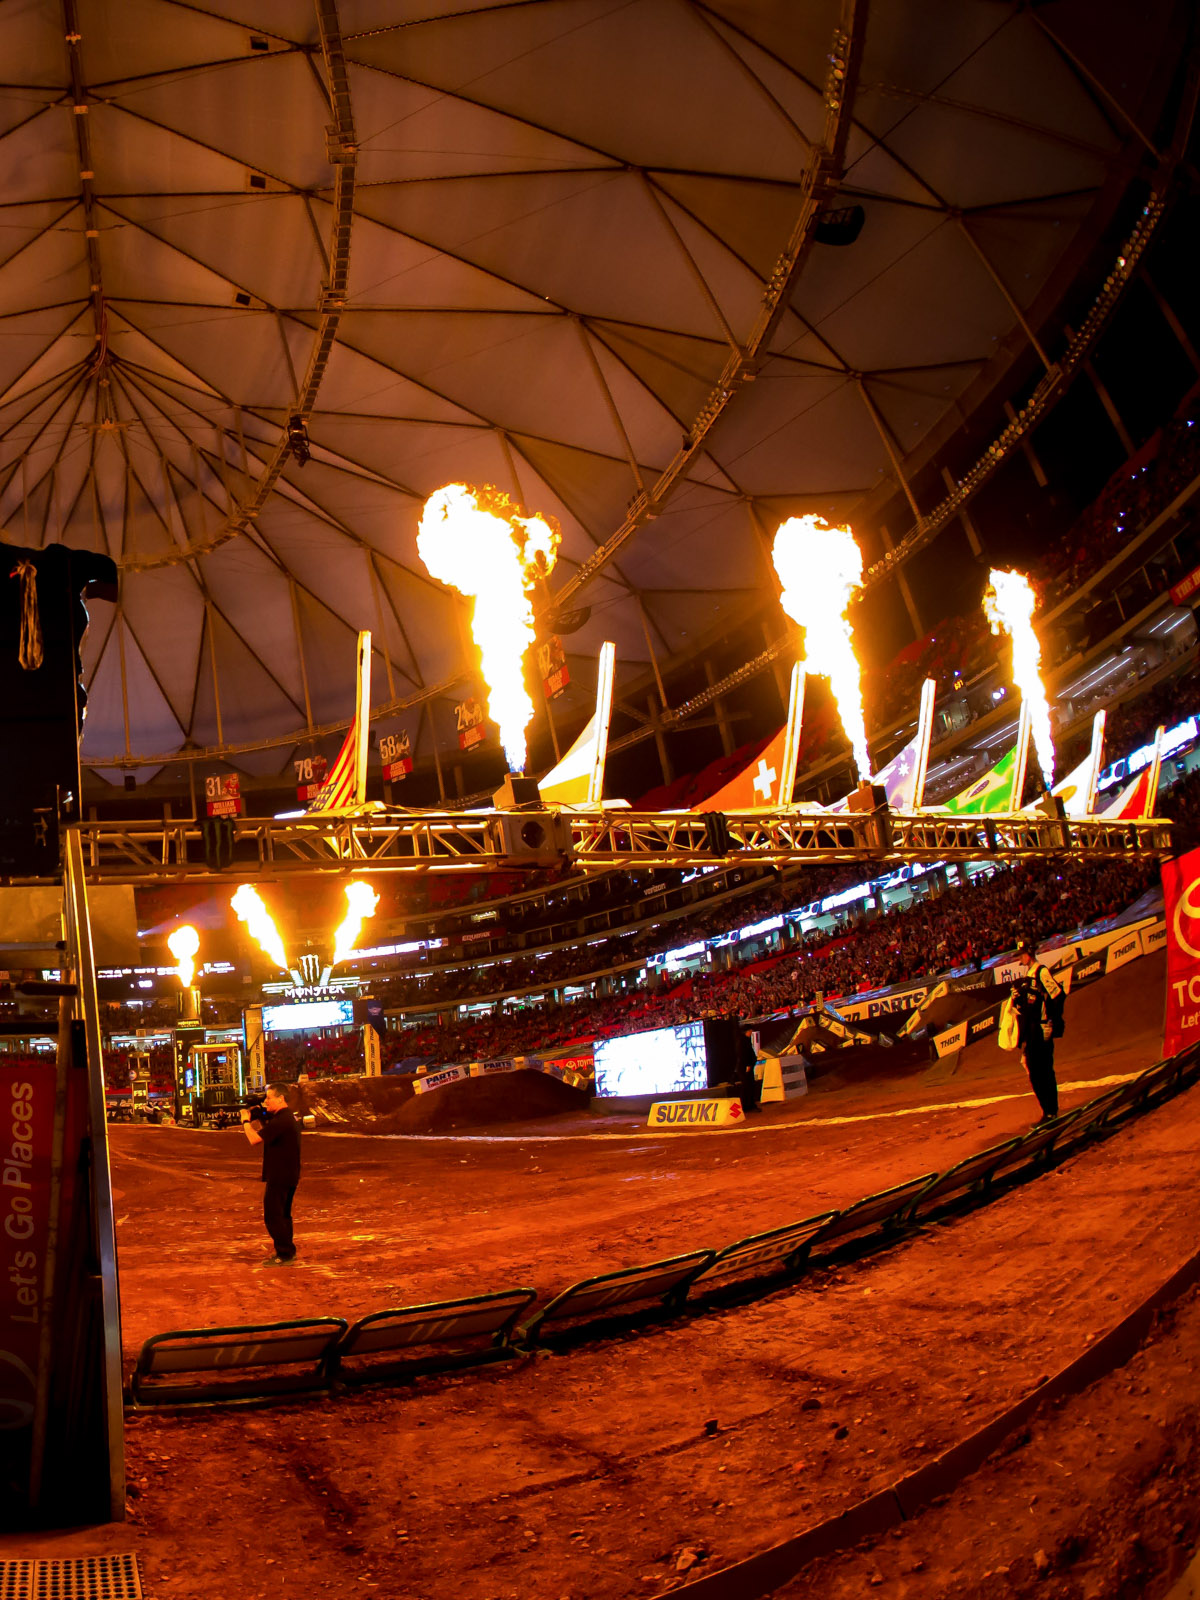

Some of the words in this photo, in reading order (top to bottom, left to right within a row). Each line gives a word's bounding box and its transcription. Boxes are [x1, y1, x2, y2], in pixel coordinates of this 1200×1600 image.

[379, 735, 396, 760] 58
[294, 758, 314, 782] 78
[206, 777, 221, 797] 31
[1113, 941, 1136, 959] THOR
[1077, 961, 1101, 980] THOR
[284, 984, 345, 998] MONSTER
[868, 992, 925, 1017] PARTS
[971, 1016, 994, 1033] THOR
[940, 1034, 961, 1049] THOR
[177, 1054, 183, 1062] 2
[484, 1061, 512, 1069] PARTS
[178, 1066, 184, 1074] 3
[426, 1069, 460, 1085] PARTS
[179, 1089, 185, 1097] 5
[656, 1103, 719, 1123] SUZUKI
[2, 1082, 35, 1191] Places
[4, 1194, 36, 1240] Go
[8, 1250, 38, 1324] Let's
